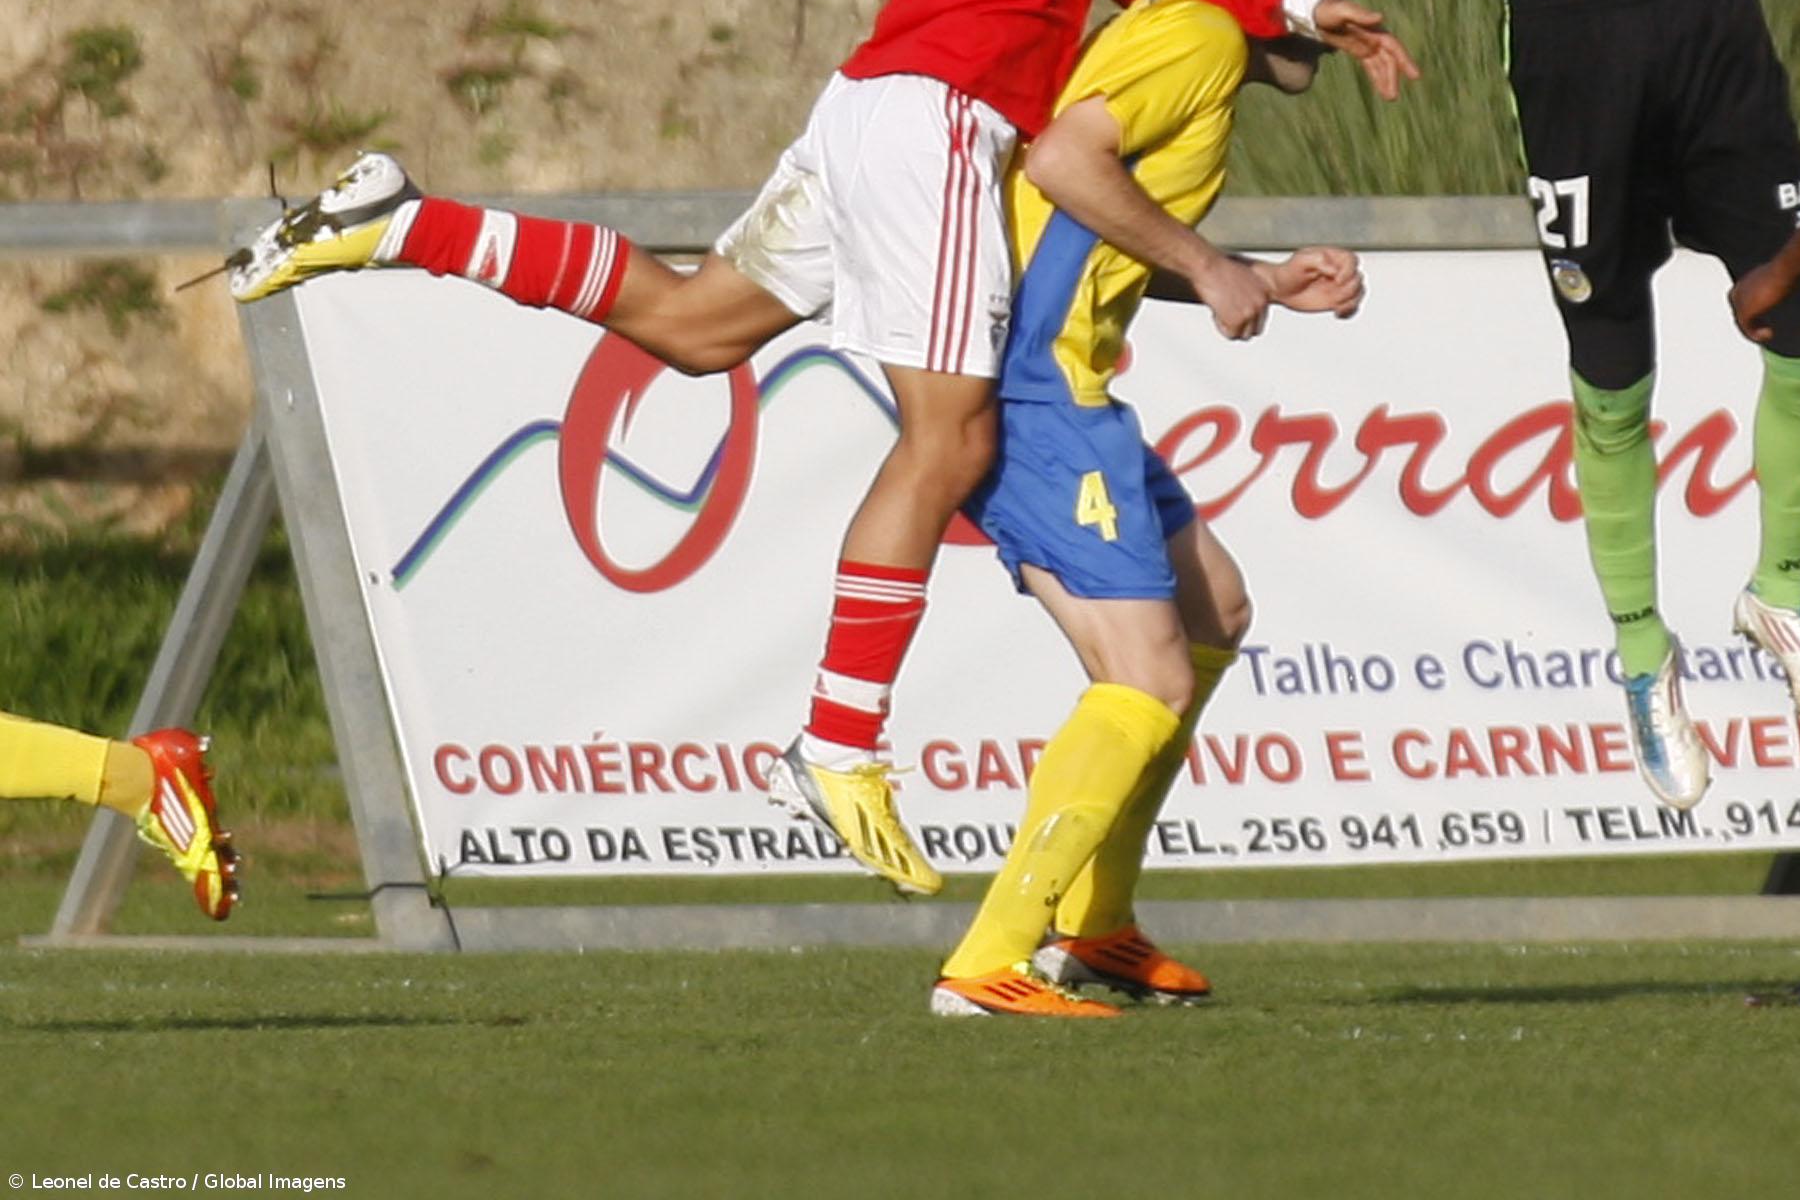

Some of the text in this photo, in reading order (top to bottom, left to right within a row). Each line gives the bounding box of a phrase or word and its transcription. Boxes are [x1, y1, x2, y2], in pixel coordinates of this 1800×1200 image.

[1528, 176, 1590, 249] 27
[1076, 471, 1118, 542] 4
[1238, 638, 1395, 695] Talho
[1414, 651, 1446, 690] e
[434, 732, 785, 795] COMÉRCIO
[1325, 730, 1372, 782] E
[1394, 722, 1634, 780] CARNE
[460, 826, 571, 864] ALTO
[588, 826, 640, 863] DA
[662, 824, 846, 864] ESTRAD
[1242, 816, 1328, 853] 256
[1342, 812, 1423, 850] 941
